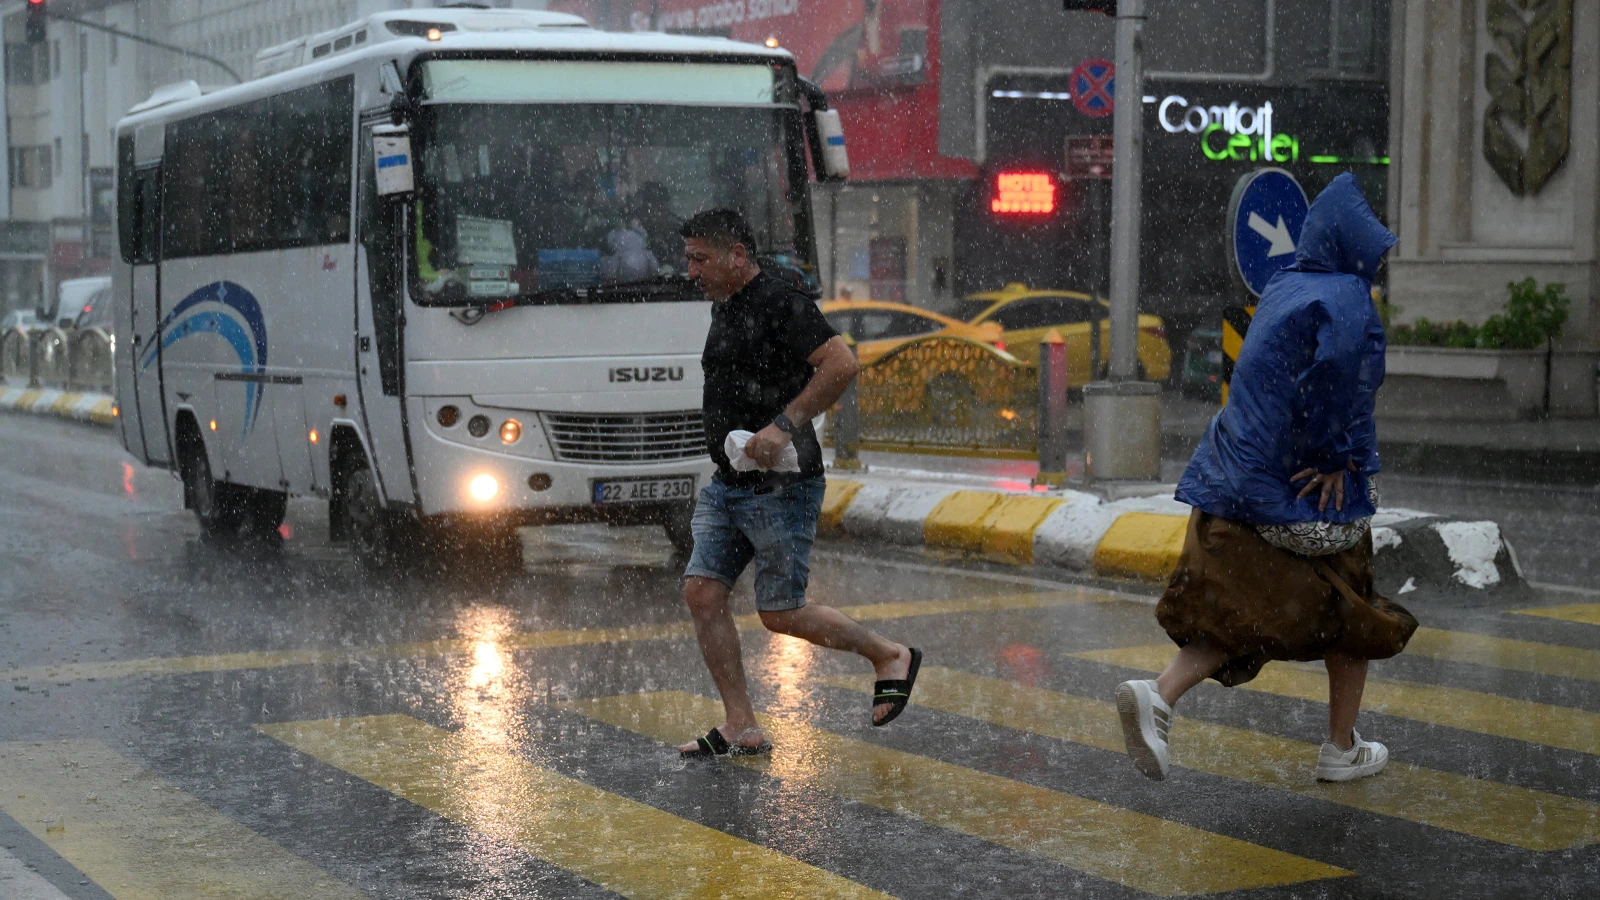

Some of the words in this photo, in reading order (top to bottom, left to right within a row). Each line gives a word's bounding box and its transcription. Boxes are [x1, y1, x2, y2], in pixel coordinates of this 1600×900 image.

[1158, 95, 1273, 161] Comfort
[609, 366, 684, 383] ISUZU
[603, 484, 622, 500] 22
[662, 480, 691, 497] 230
